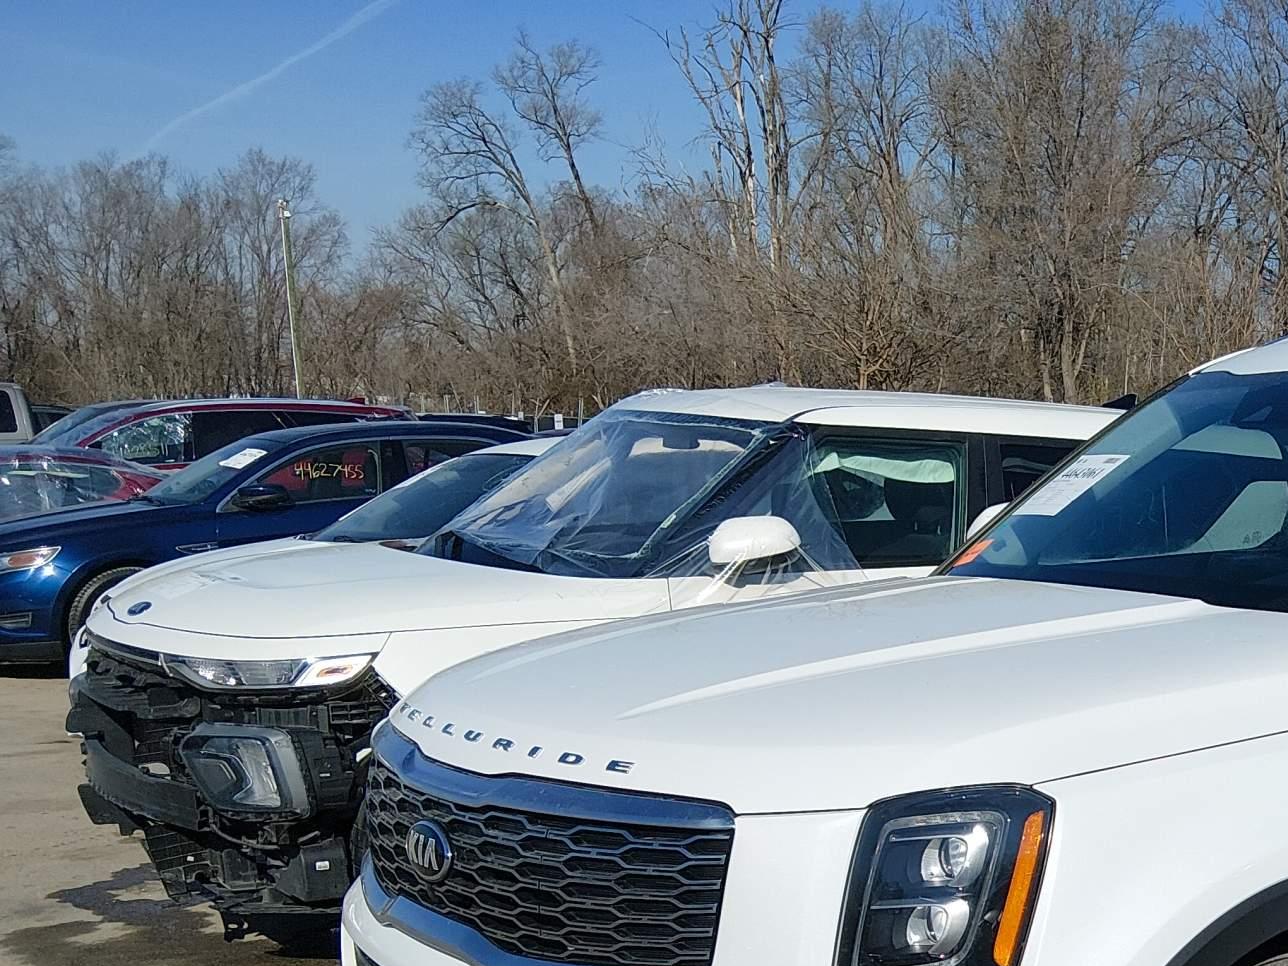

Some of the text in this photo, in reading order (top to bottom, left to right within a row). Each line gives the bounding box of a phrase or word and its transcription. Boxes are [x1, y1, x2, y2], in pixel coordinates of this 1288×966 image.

[293, 462, 365, 481] 44627455
[400, 702, 636, 775] TELLURIDE
[406, 828, 440, 872] KIA
